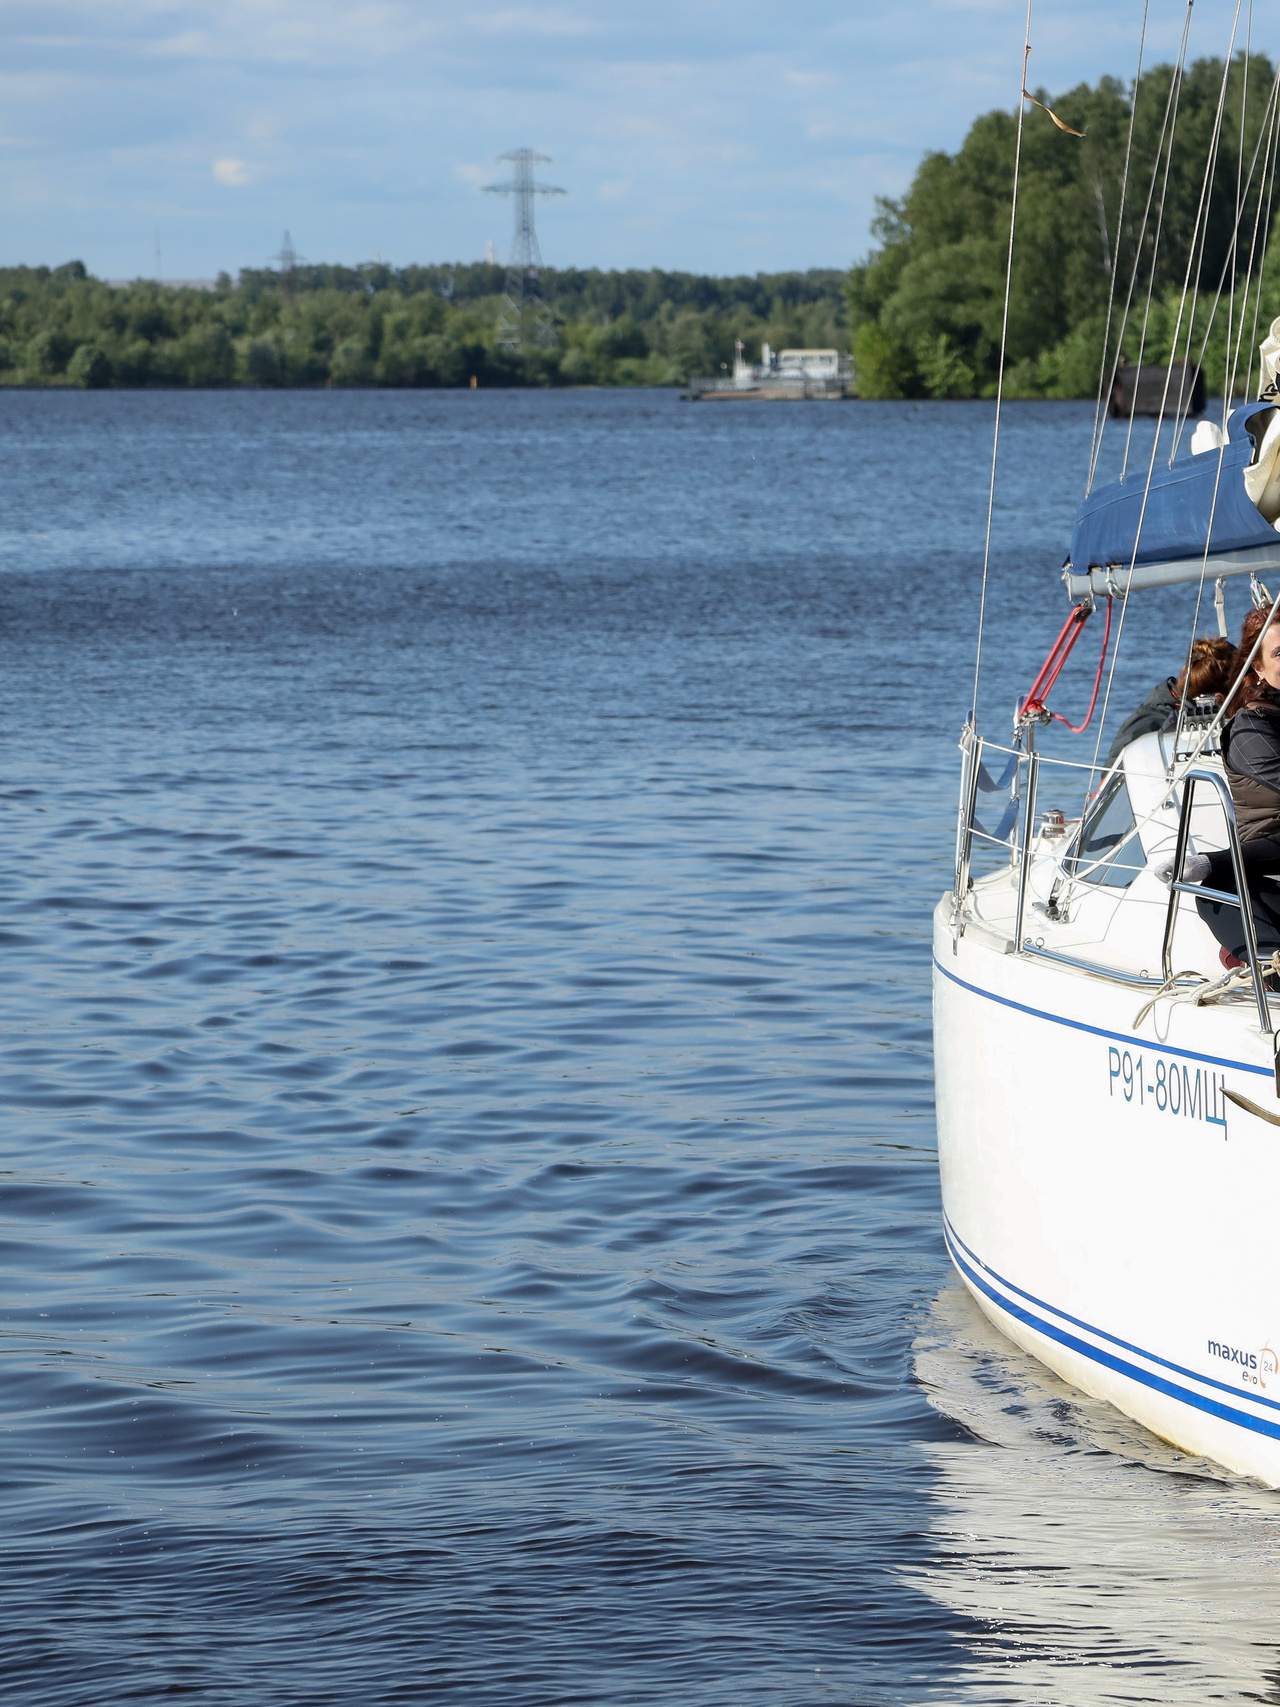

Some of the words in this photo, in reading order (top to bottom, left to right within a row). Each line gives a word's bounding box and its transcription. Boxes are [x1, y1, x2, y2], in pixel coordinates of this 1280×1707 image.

[1208, 1340, 1257, 1369] maxus
[1263, 1361, 1273, 1373] 24
[1242, 1371, 1258, 1384] evo
